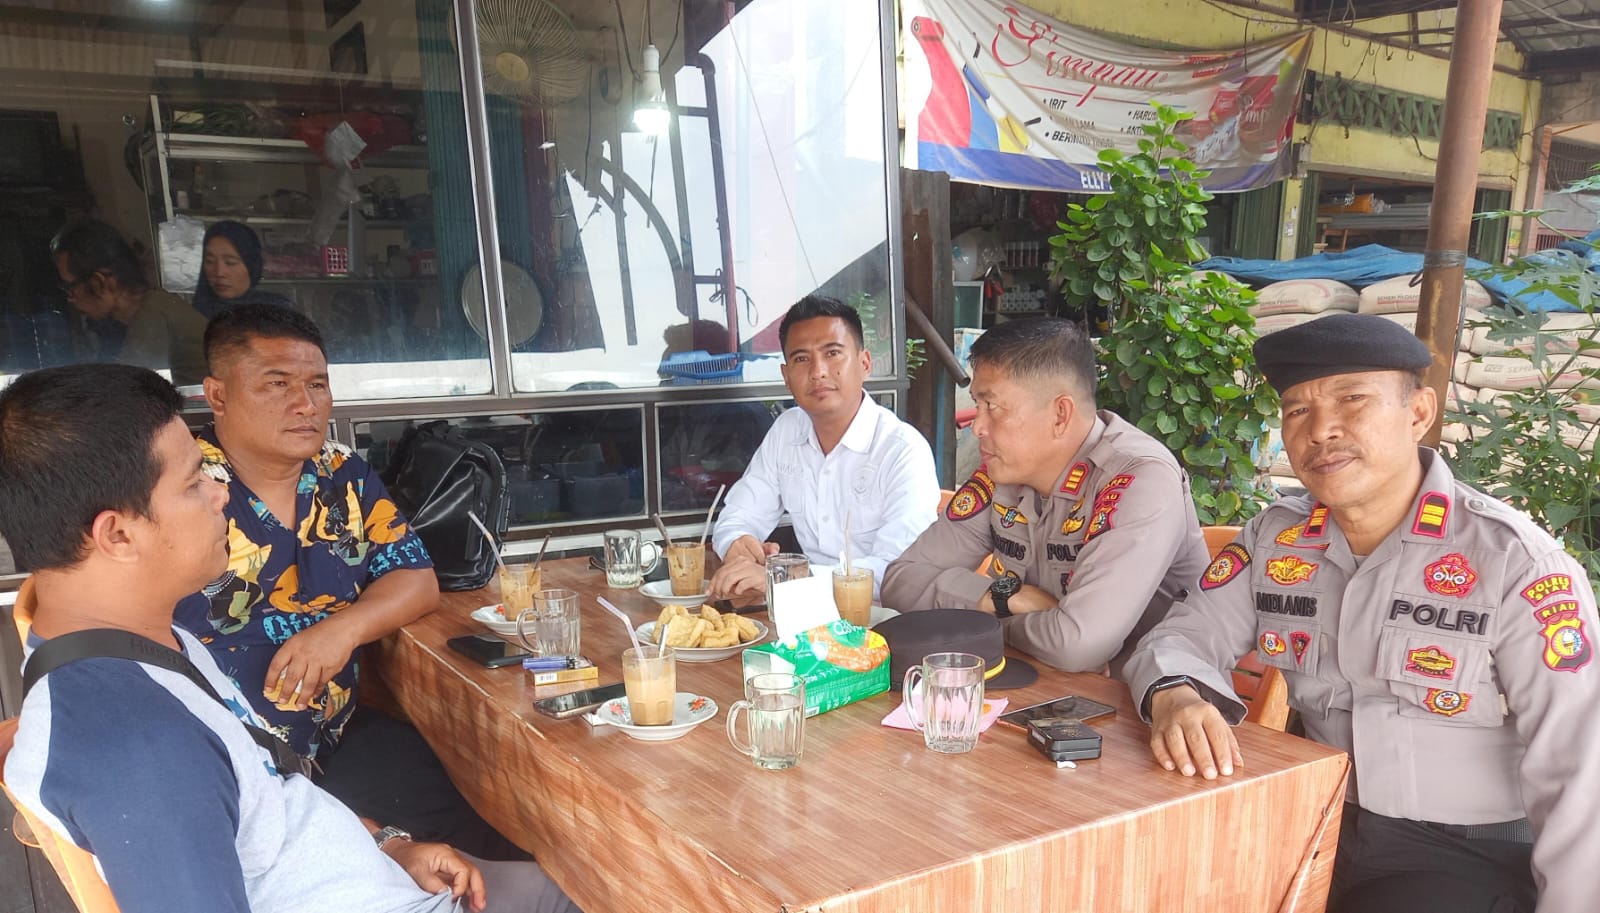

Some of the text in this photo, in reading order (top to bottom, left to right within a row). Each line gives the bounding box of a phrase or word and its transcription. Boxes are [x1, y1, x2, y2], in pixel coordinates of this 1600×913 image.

[1049, 98, 1067, 110] IRIT
[1080, 171, 1105, 190] ELLY
[1389, 599, 1490, 636] POLRI
[1541, 602, 1577, 618] RIAU
